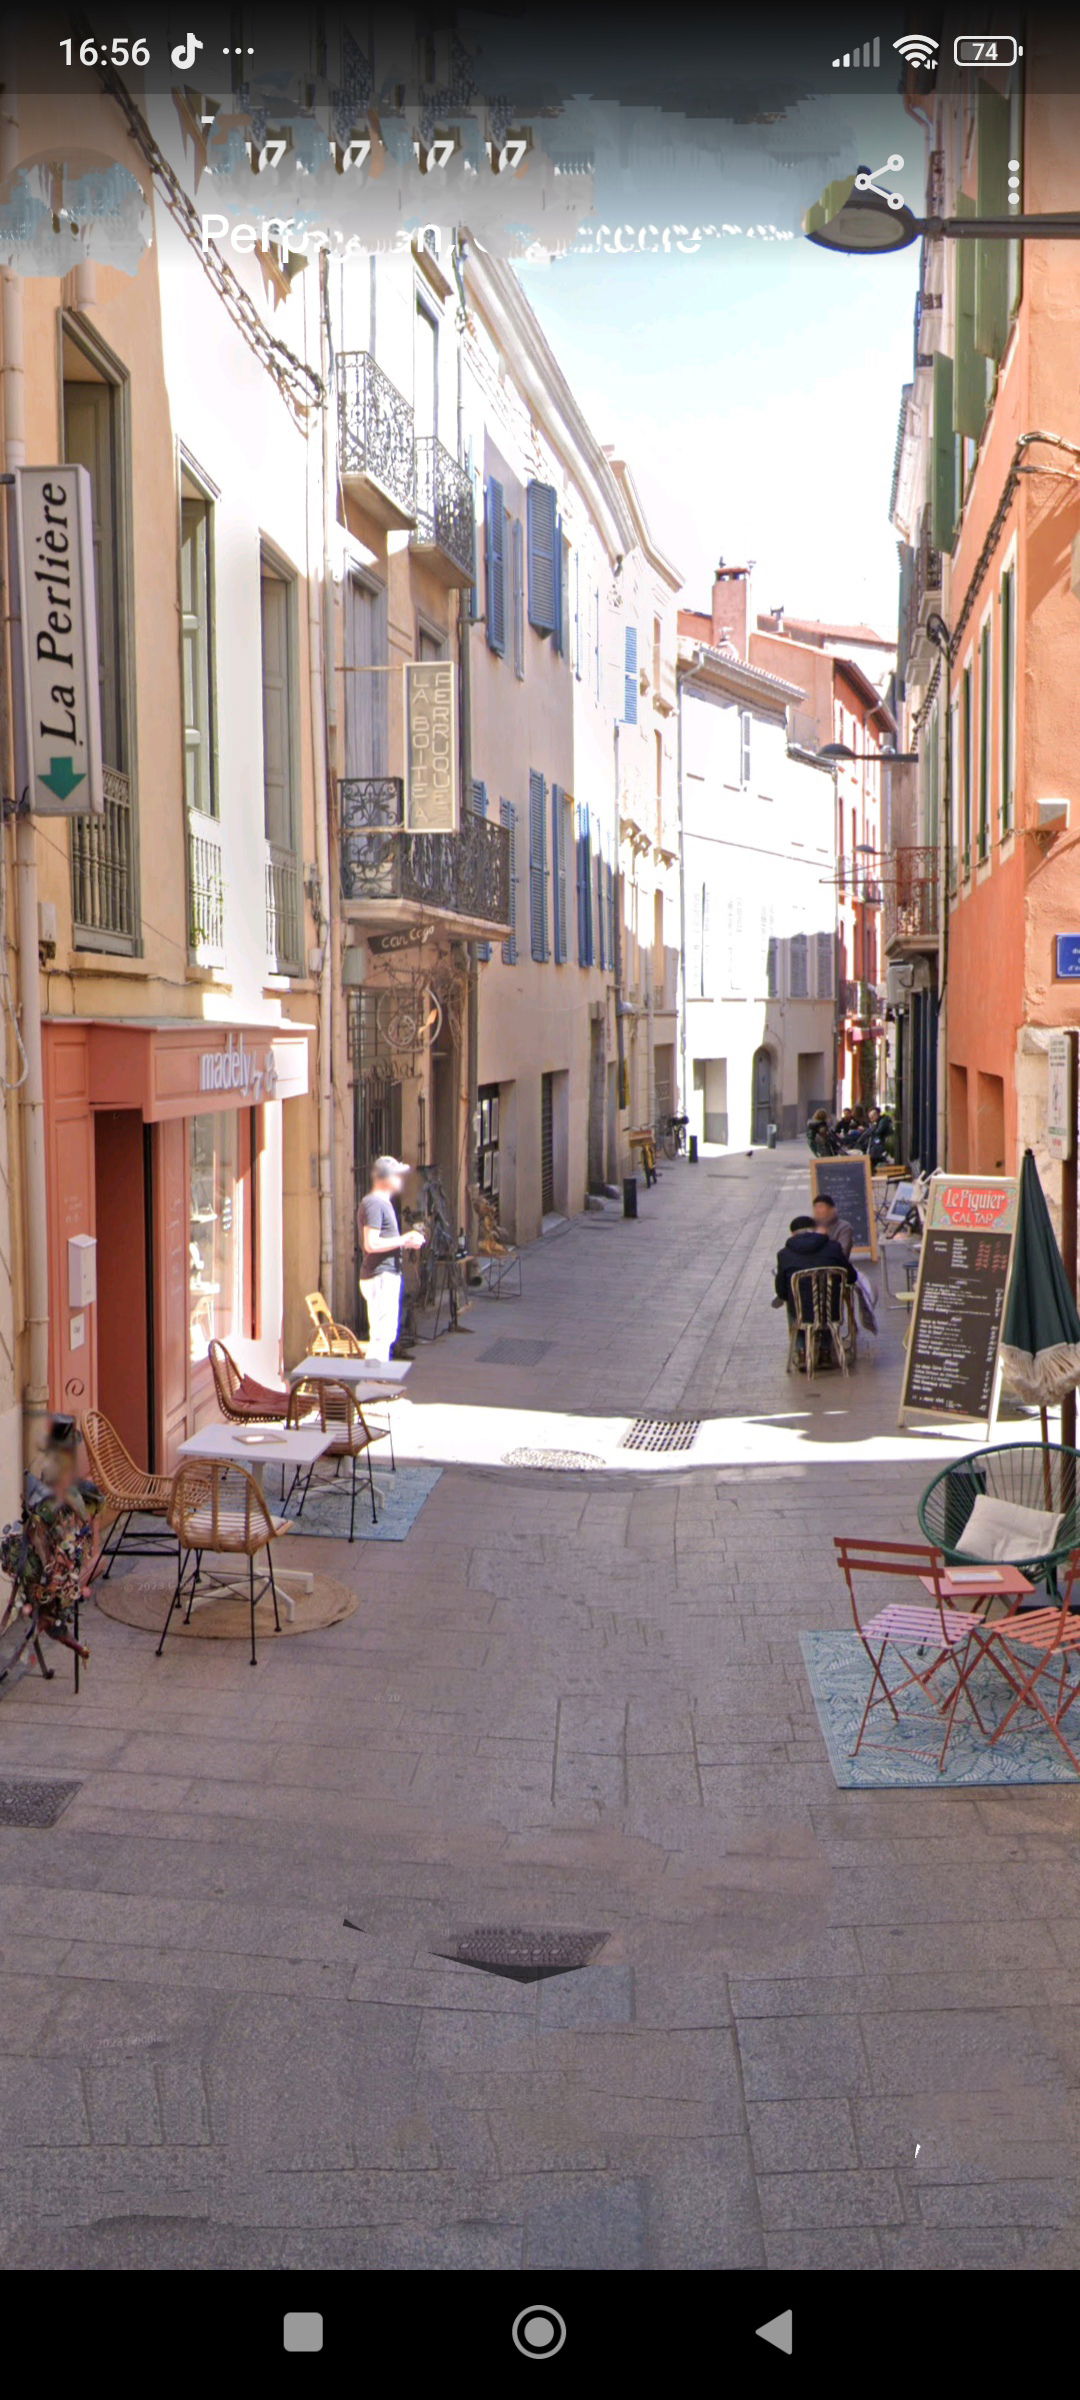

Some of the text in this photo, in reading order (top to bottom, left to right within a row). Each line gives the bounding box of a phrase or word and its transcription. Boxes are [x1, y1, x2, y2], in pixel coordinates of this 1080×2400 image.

[35, 482, 78, 746] La Perlière
[412, 672, 430, 704] LA
